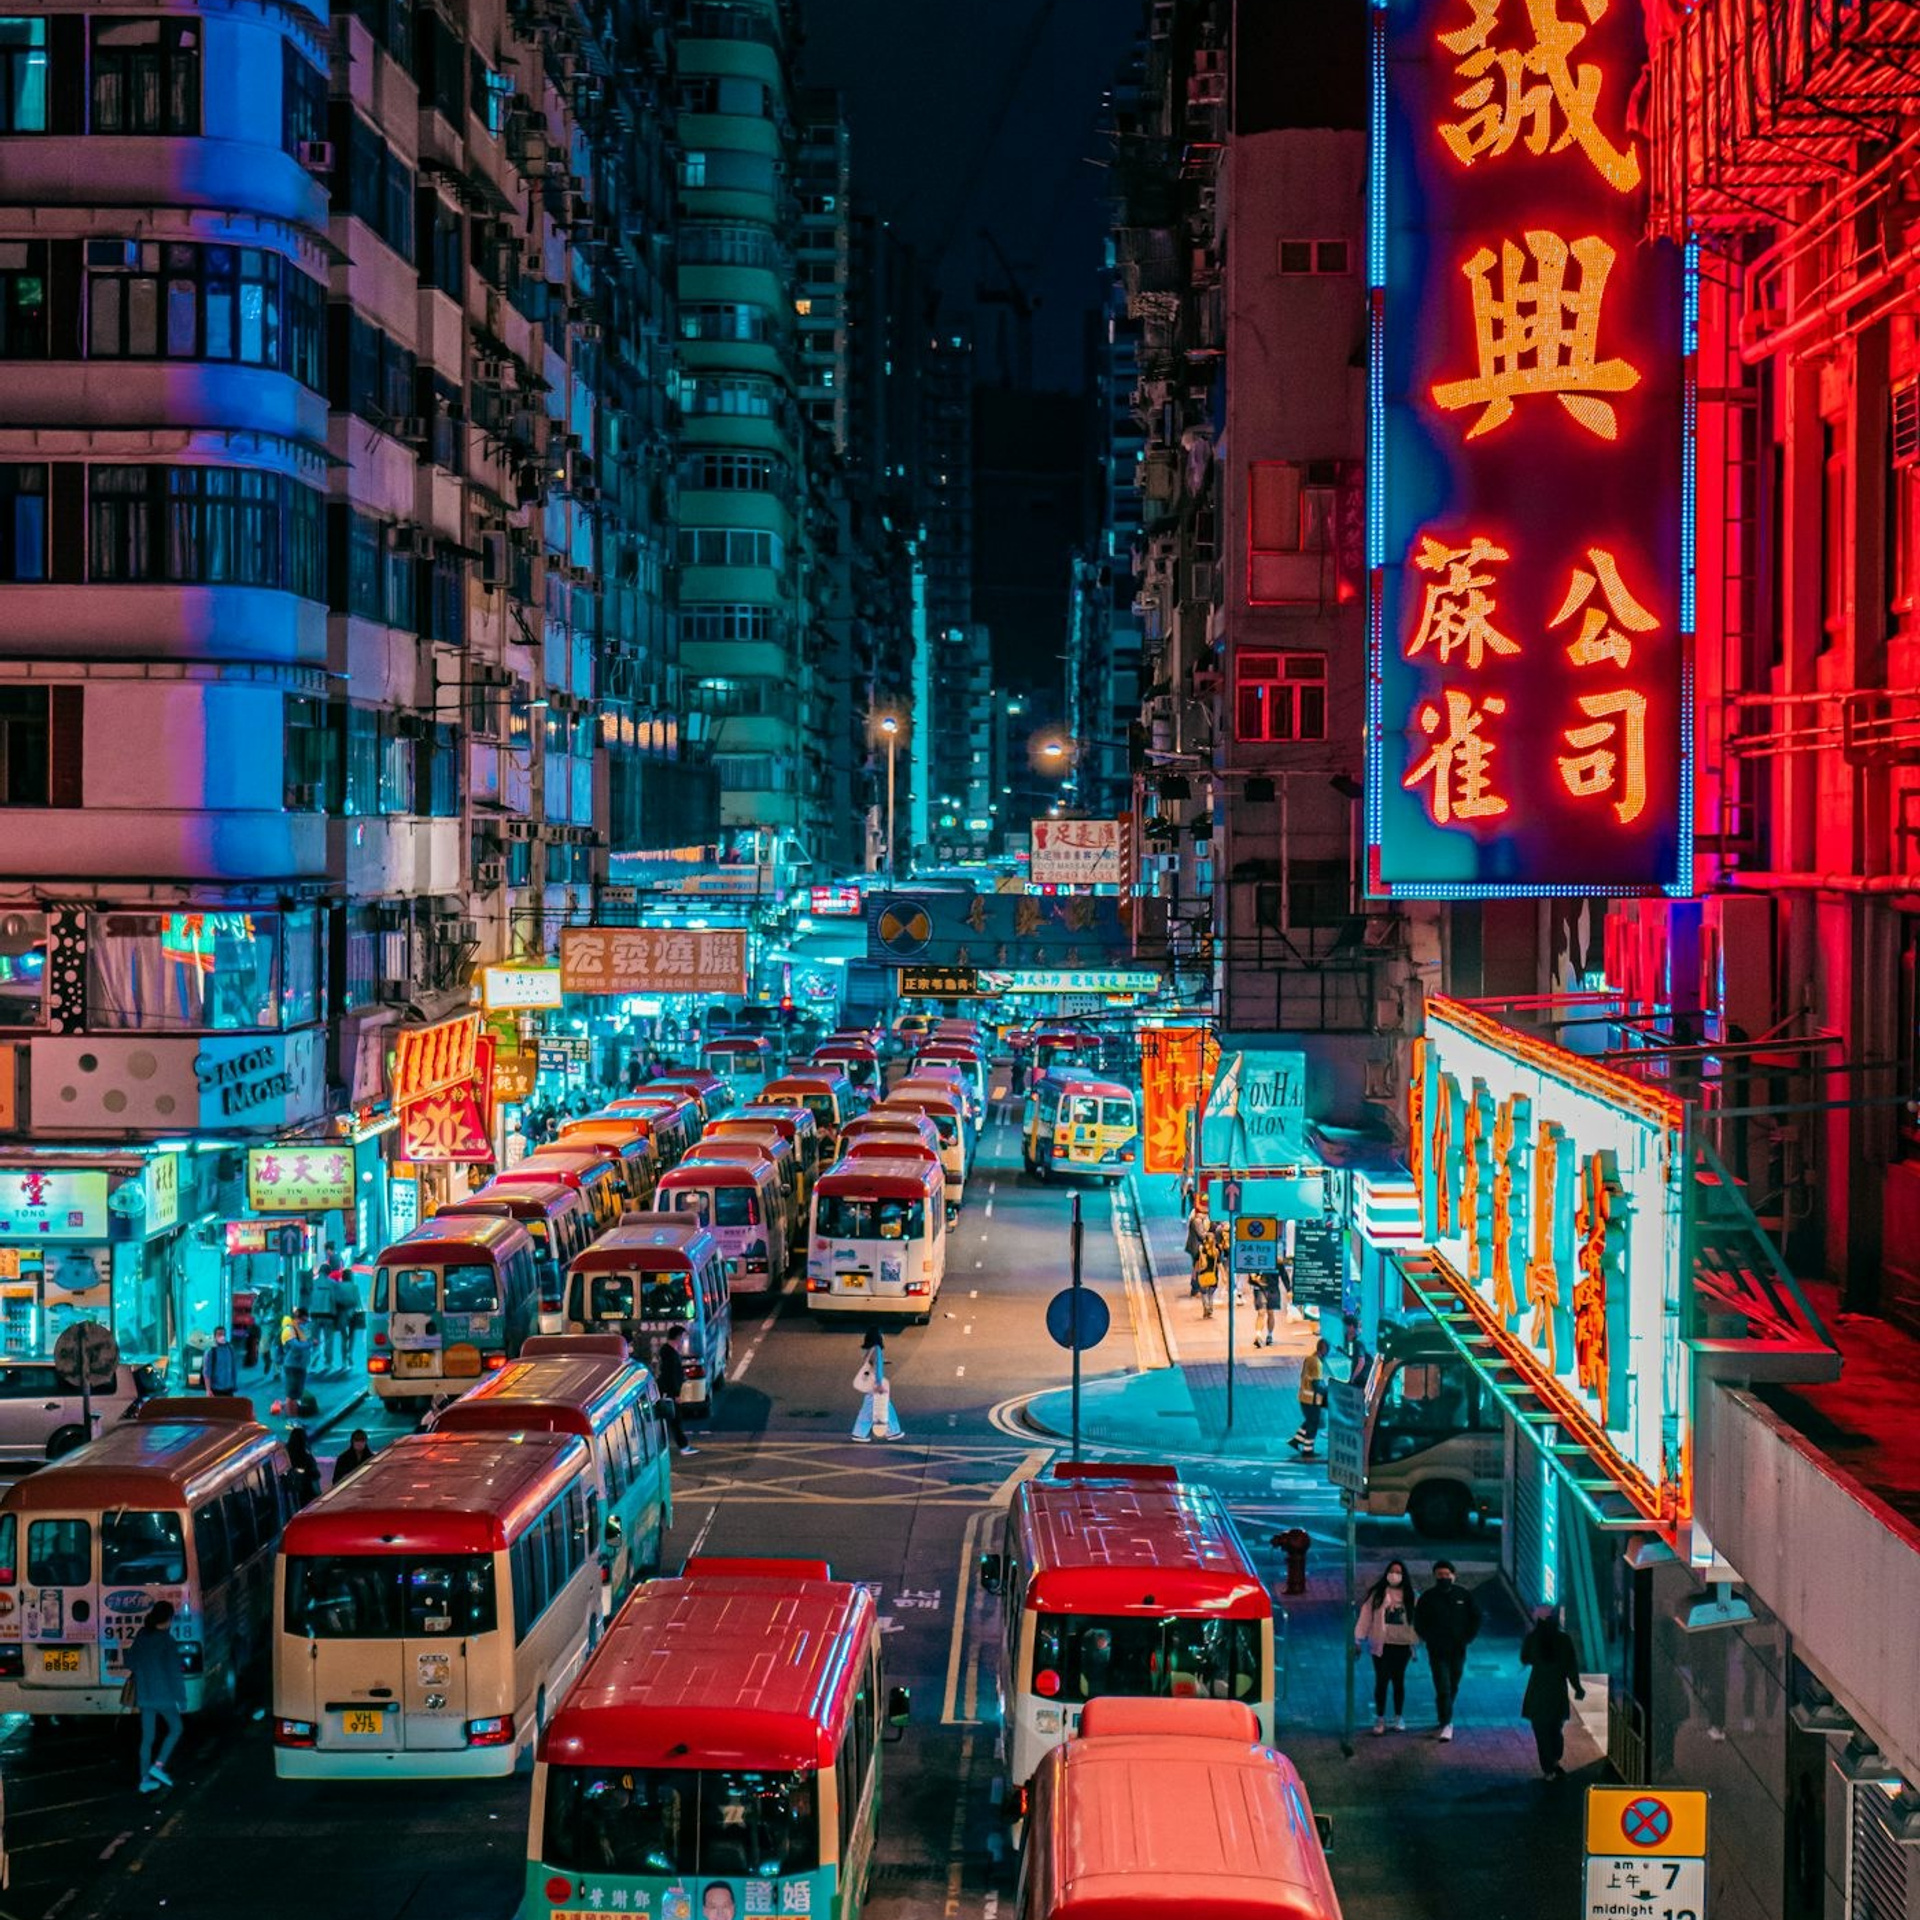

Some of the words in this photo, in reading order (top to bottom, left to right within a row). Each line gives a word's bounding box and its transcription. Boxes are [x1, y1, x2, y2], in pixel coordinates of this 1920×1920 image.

[1548, 546, 1661, 825] 公司
[565, 933, 739, 974] 宏發燒臘
[418, 1117, 458, 1148] 20
[255, 1153, 351, 1185] 海天堂
[15, 1209, 46, 1218] TONG
[1240, 1244, 1253, 1252] 24
[1257, 1244, 1271, 1252] hrs
[350, 1722, 376, 1732] 975
[355, 1712, 372, 1722] VH
[1606, 1873, 1641, 1889] 上午
[1614, 1861, 1633, 1869] am
[1662, 1864, 1680, 1890] 7
[745, 1880, 811, 1912] 證婚
[1592, 1904, 1653, 1916] midnight
